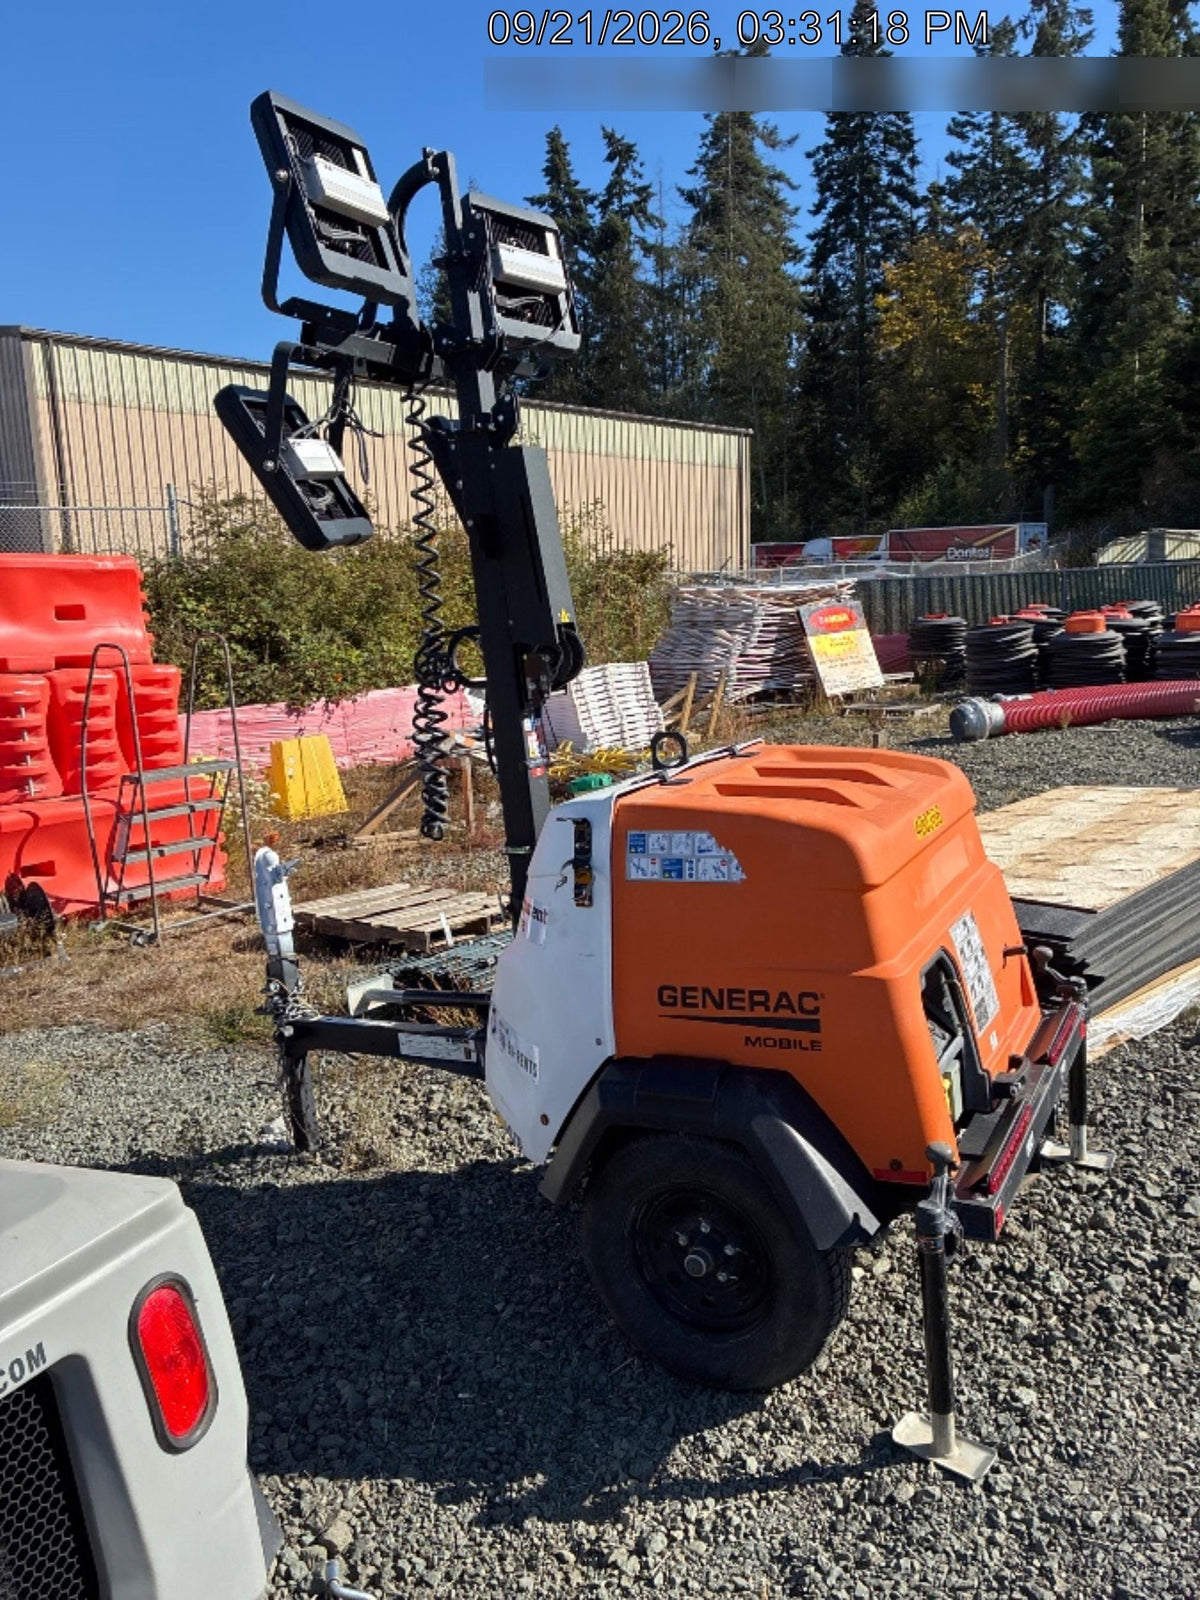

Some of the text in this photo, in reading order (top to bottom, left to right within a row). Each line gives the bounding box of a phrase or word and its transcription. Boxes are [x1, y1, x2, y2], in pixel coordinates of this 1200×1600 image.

[947, 546, 990, 560] Doritos
[657, 984, 821, 1016] GENERAC
[744, 1035, 823, 1052] MOBILE
